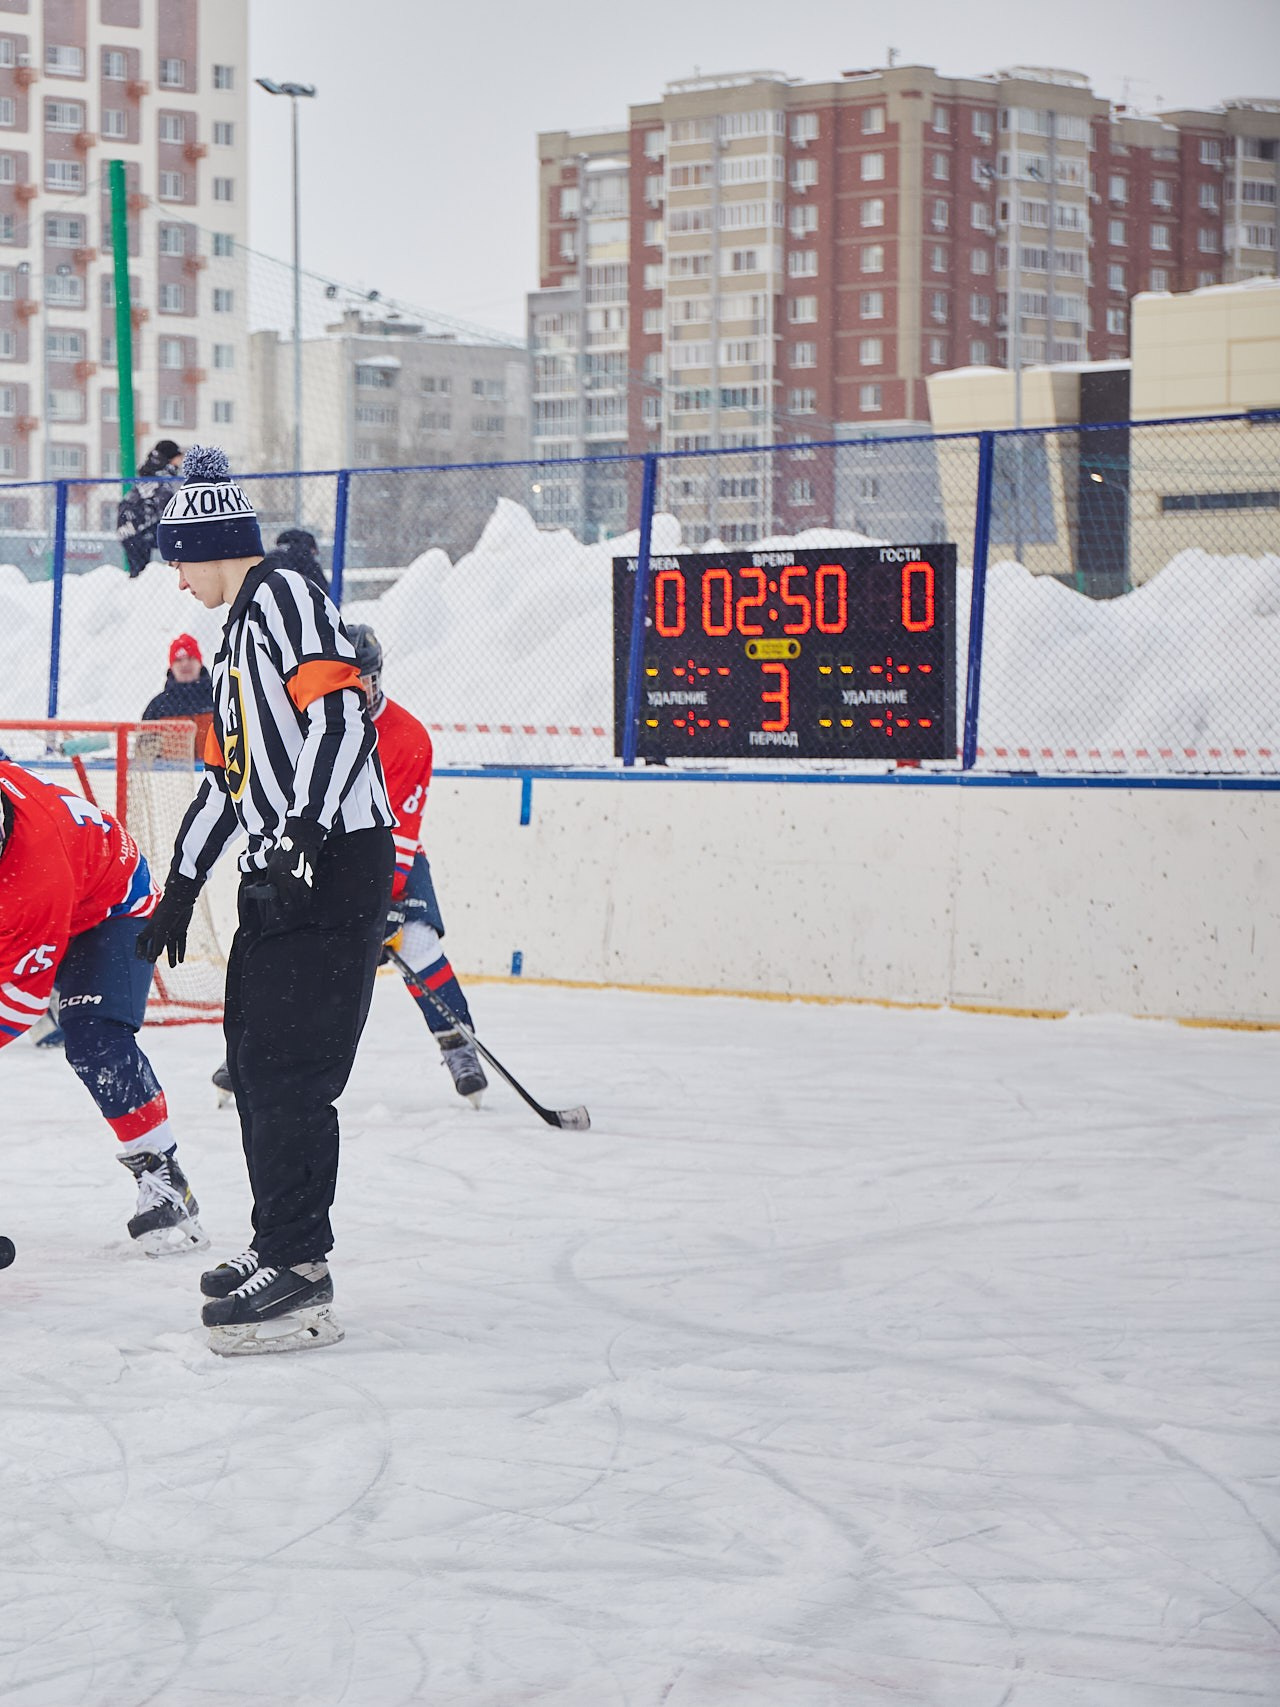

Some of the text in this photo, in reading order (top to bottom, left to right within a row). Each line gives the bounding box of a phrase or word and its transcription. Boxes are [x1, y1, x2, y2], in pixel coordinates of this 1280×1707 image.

[182, 487, 254, 517] ХОКК
[752, 552, 795, 568] ВРЕМЯ
[880, 547, 921, 563] ГОСТИ
[655, 570, 686, 638] 0
[701, 563, 848, 637] 02:50
[901, 561, 935, 633] 0
[647, 690, 708, 707] УДАЛЕНИЕ
[761, 662, 790, 732] 3
[841, 689, 908, 707] УДАЛЕНИЕ
[749, 731, 799, 748] ПЕРИОД
[12, 944, 57, 977] 15
